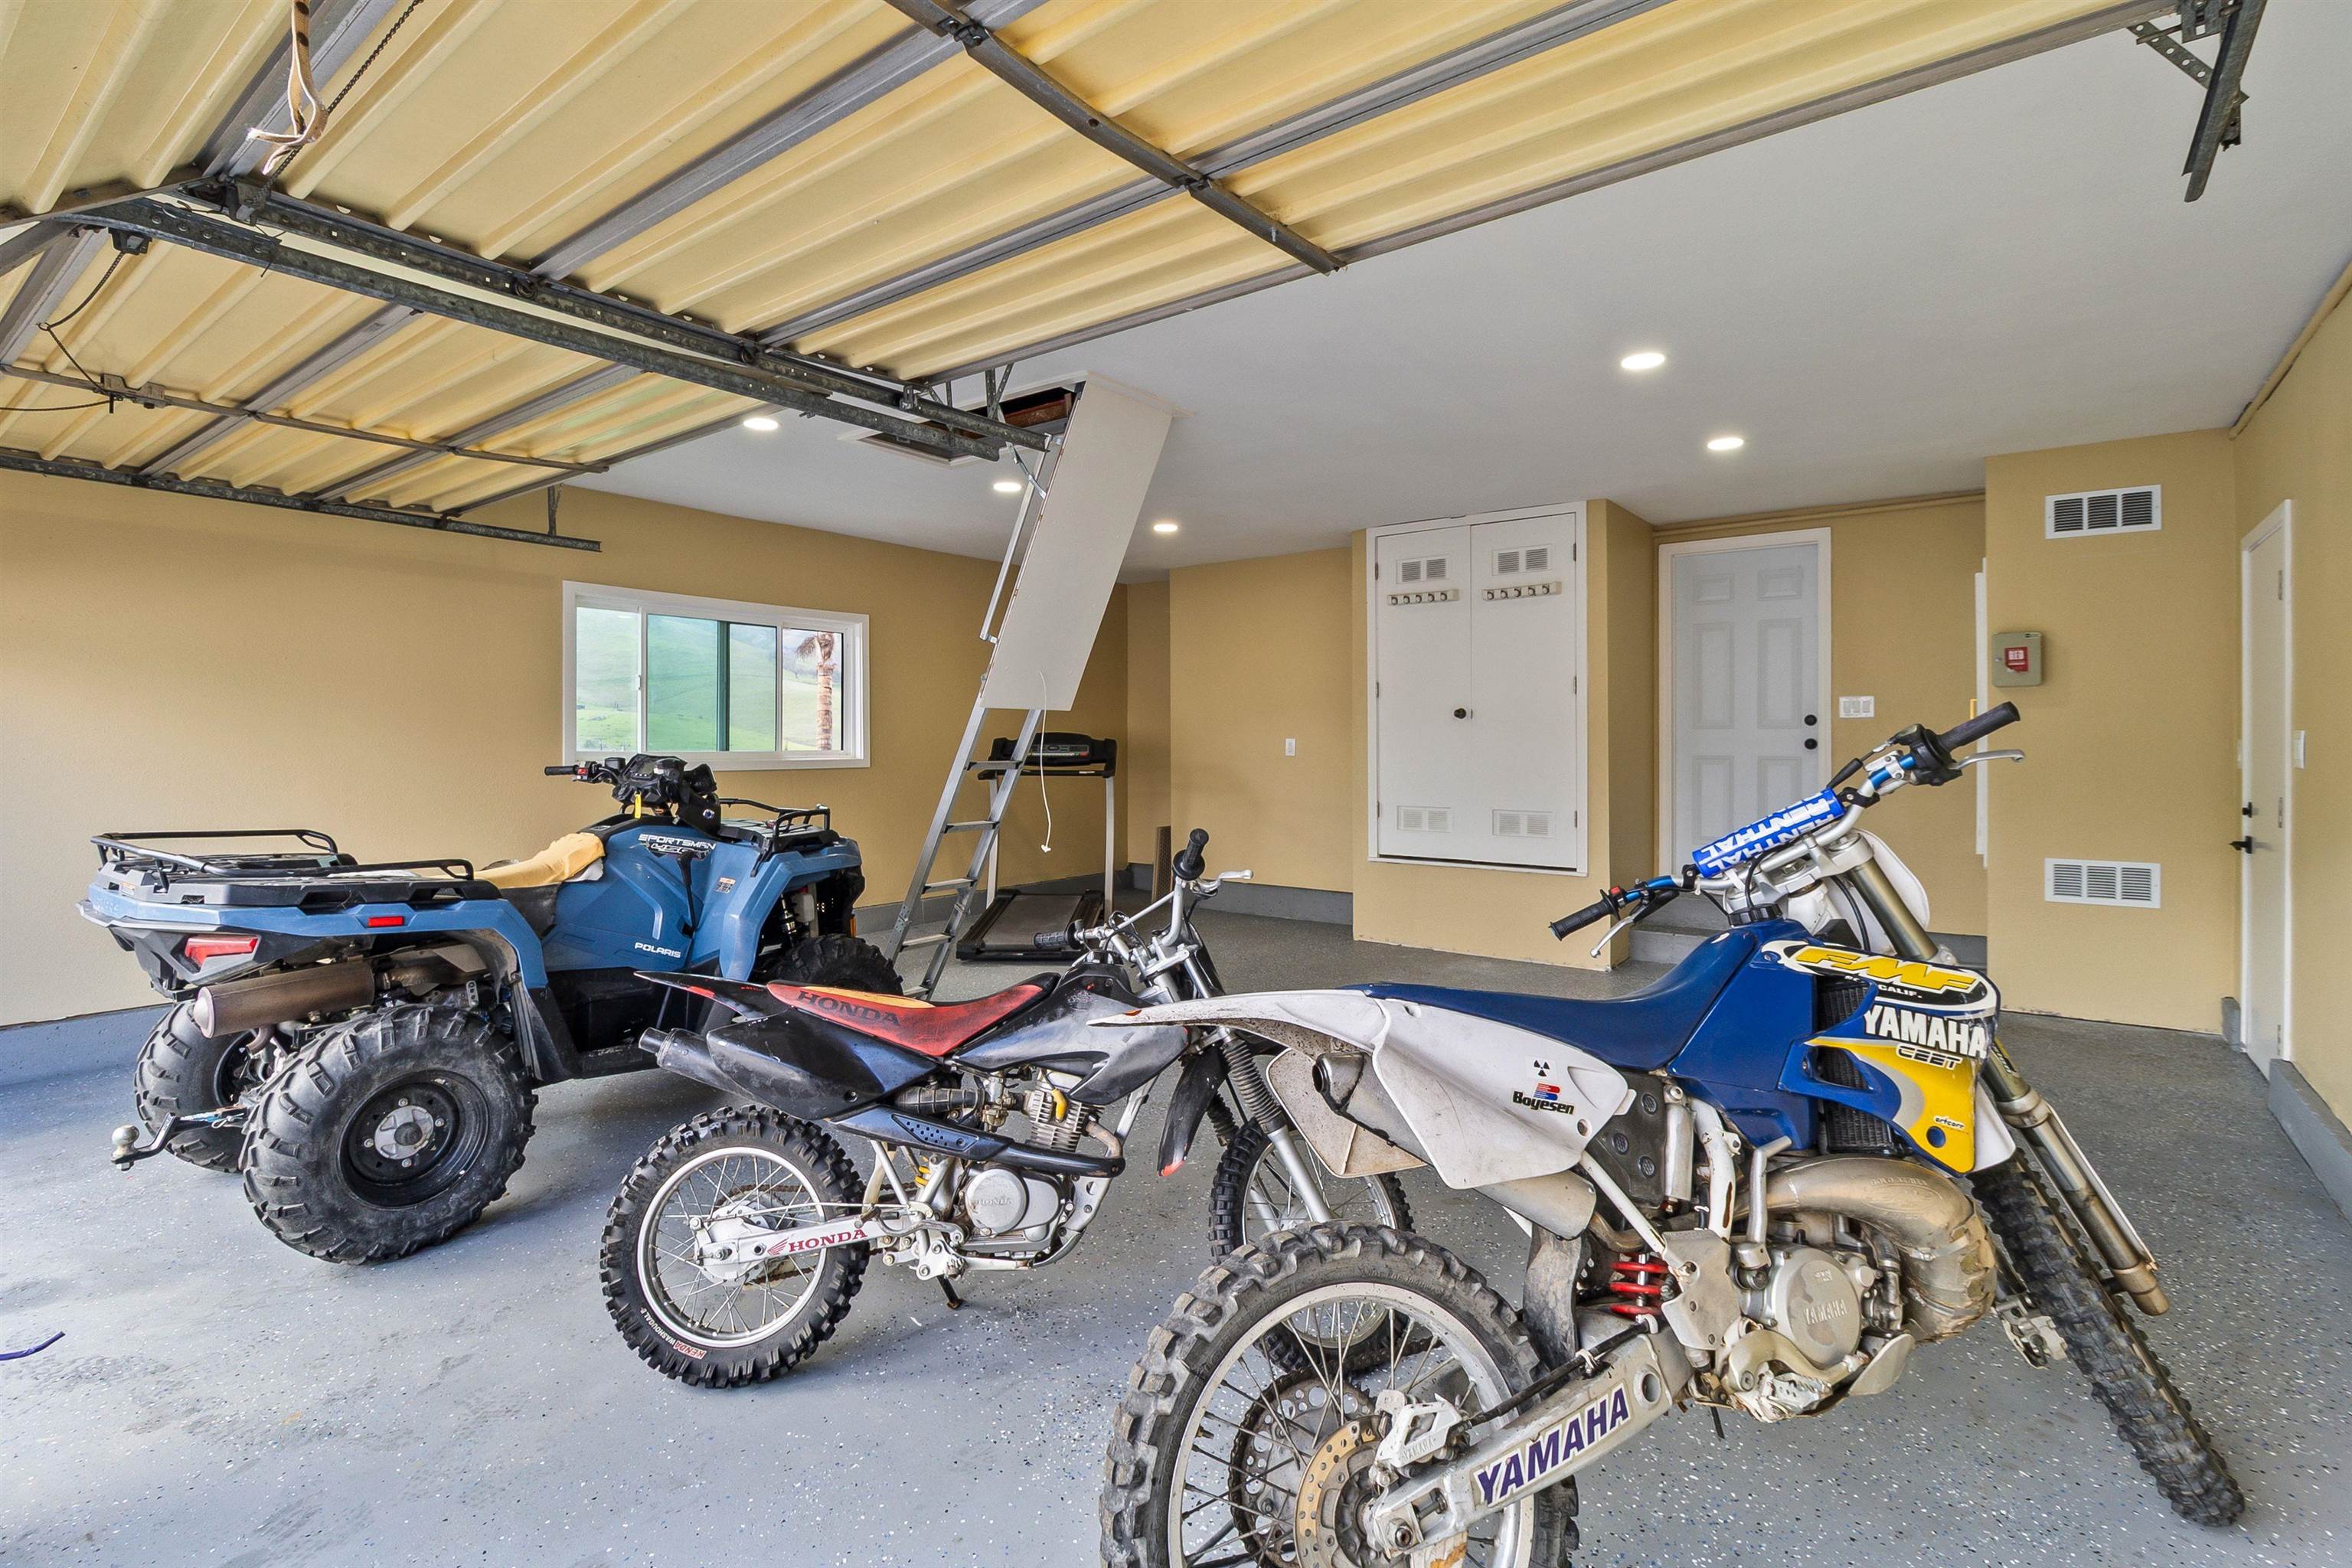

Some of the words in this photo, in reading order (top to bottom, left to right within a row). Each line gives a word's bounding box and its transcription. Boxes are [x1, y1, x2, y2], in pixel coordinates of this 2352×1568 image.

[638, 833, 717, 851] SPORTSMAN
[1700, 798, 1831, 860] RENTHAL
[634, 942, 681, 959] POLARIS
[1795, 946, 1977, 991] FMF
[796, 991, 901, 1027] HONDA
[1864, 1004, 1988, 1060] YAMAHA
[1897, 1044, 1962, 1070] CEET
[1512, 1090, 1575, 1116] Boyesen
[788, 1228, 868, 1253] HONDA
[1802, 1298, 1847, 1325] YAMAHA
[644, 1312, 675, 1346] WASHOUGAL
[674, 1341, 707, 1360] KENDA
[1477, 1387, 1630, 1505] YAMAHA
